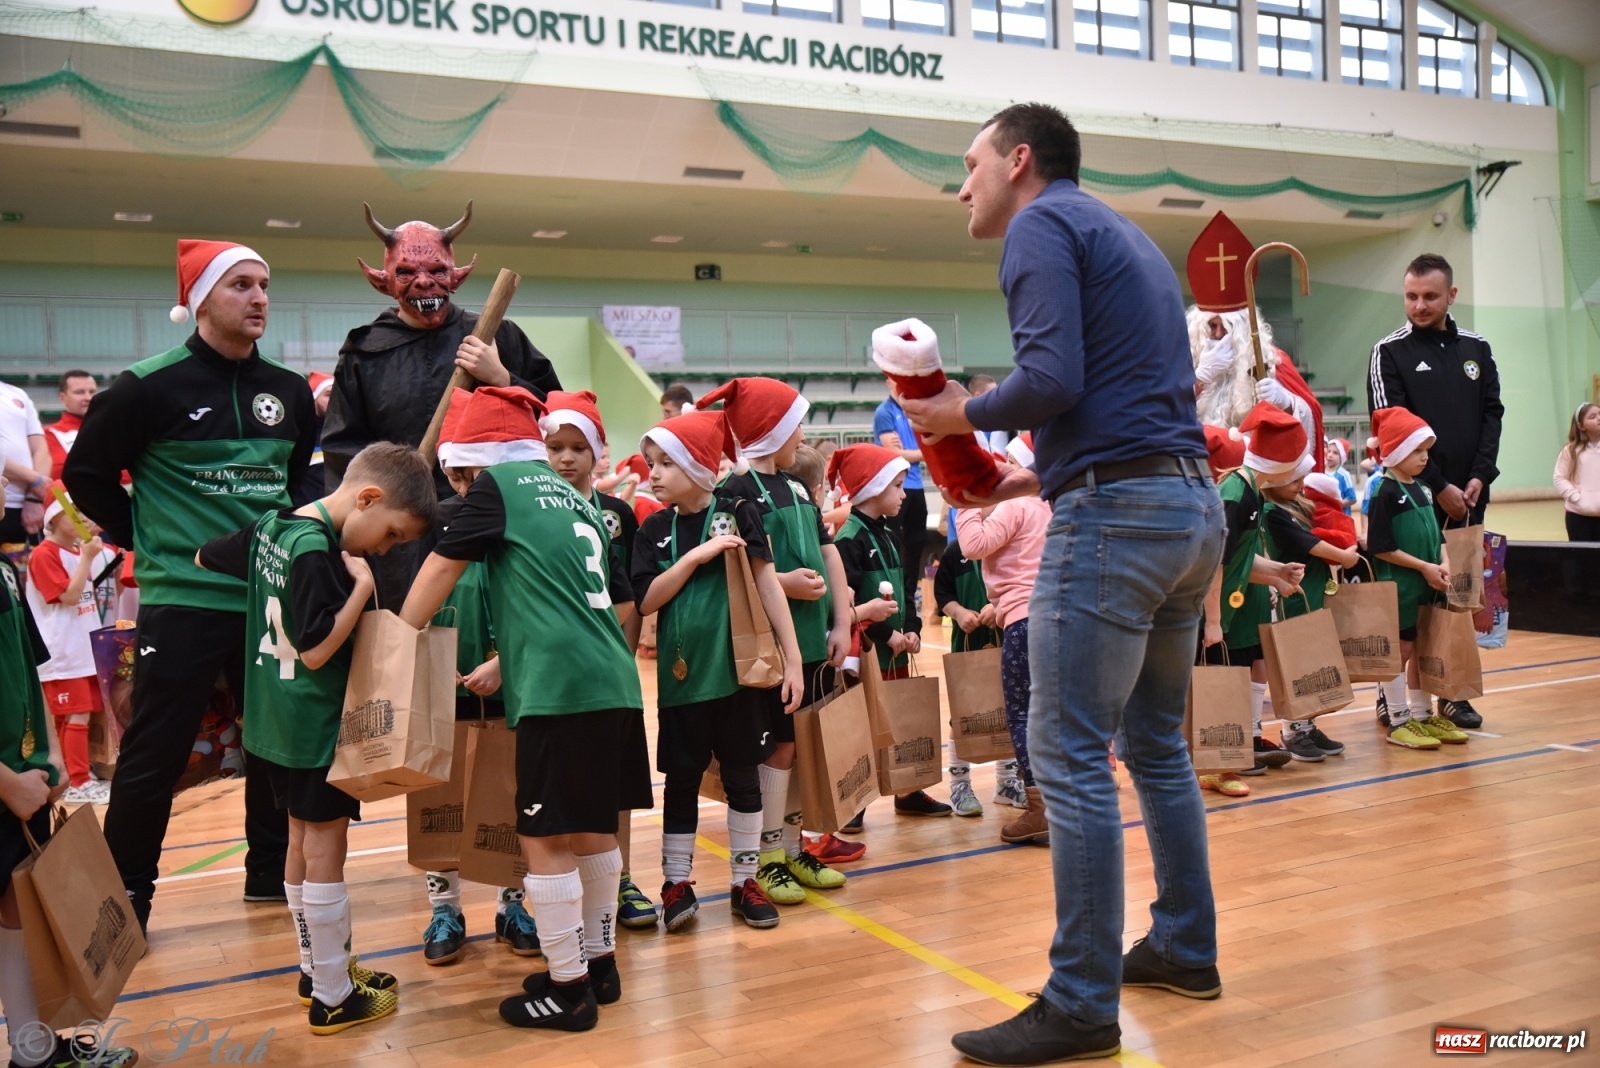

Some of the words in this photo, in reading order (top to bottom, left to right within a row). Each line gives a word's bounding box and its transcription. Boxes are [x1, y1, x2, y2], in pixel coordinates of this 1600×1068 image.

[472, 3, 605, 45] SPORTU
[618, 19, 625, 48] I
[639, 21, 797, 65] REKREACJI
[809, 40, 943, 80] RACIBÓRZ
[612, 309, 673, 321] MIESZKO
[573, 522, 612, 609] 3
[256, 595, 299, 679] 4
